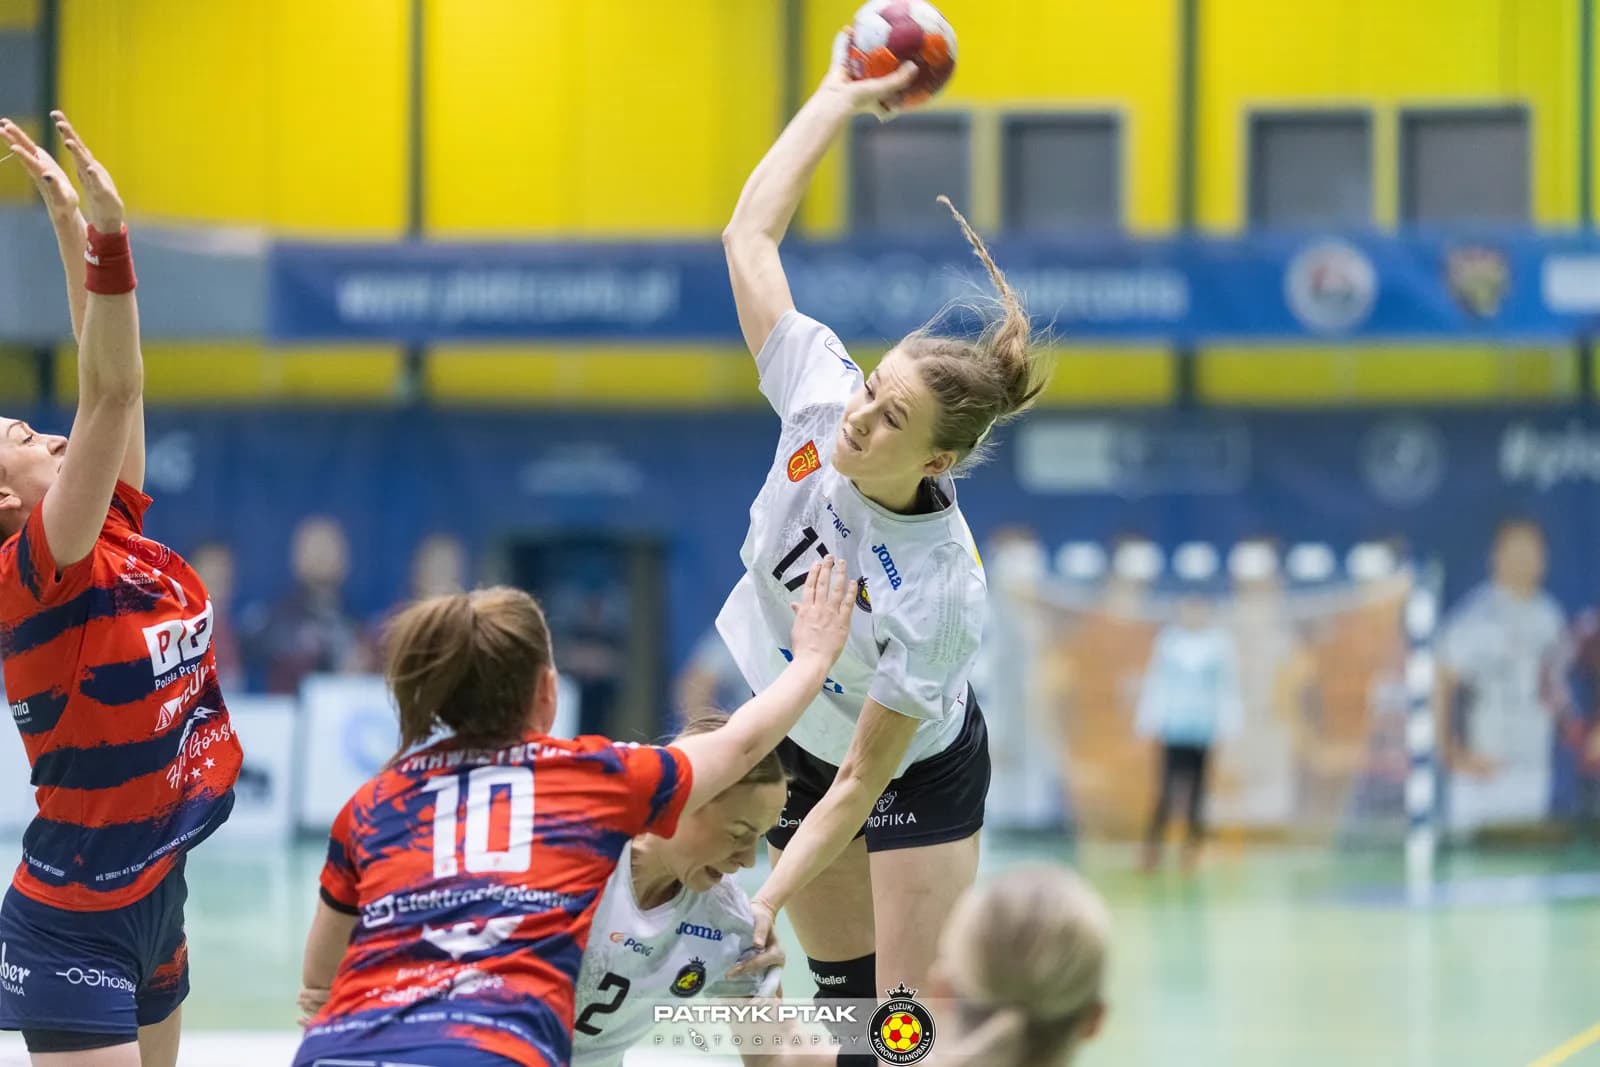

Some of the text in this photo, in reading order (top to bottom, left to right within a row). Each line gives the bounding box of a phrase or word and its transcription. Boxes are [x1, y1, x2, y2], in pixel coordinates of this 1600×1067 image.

[421, 764, 536, 879] 10
[866, 812, 917, 829] PROFIKA
[0, 941, 31, 984] ber
[574, 971, 631, 1037] 2
